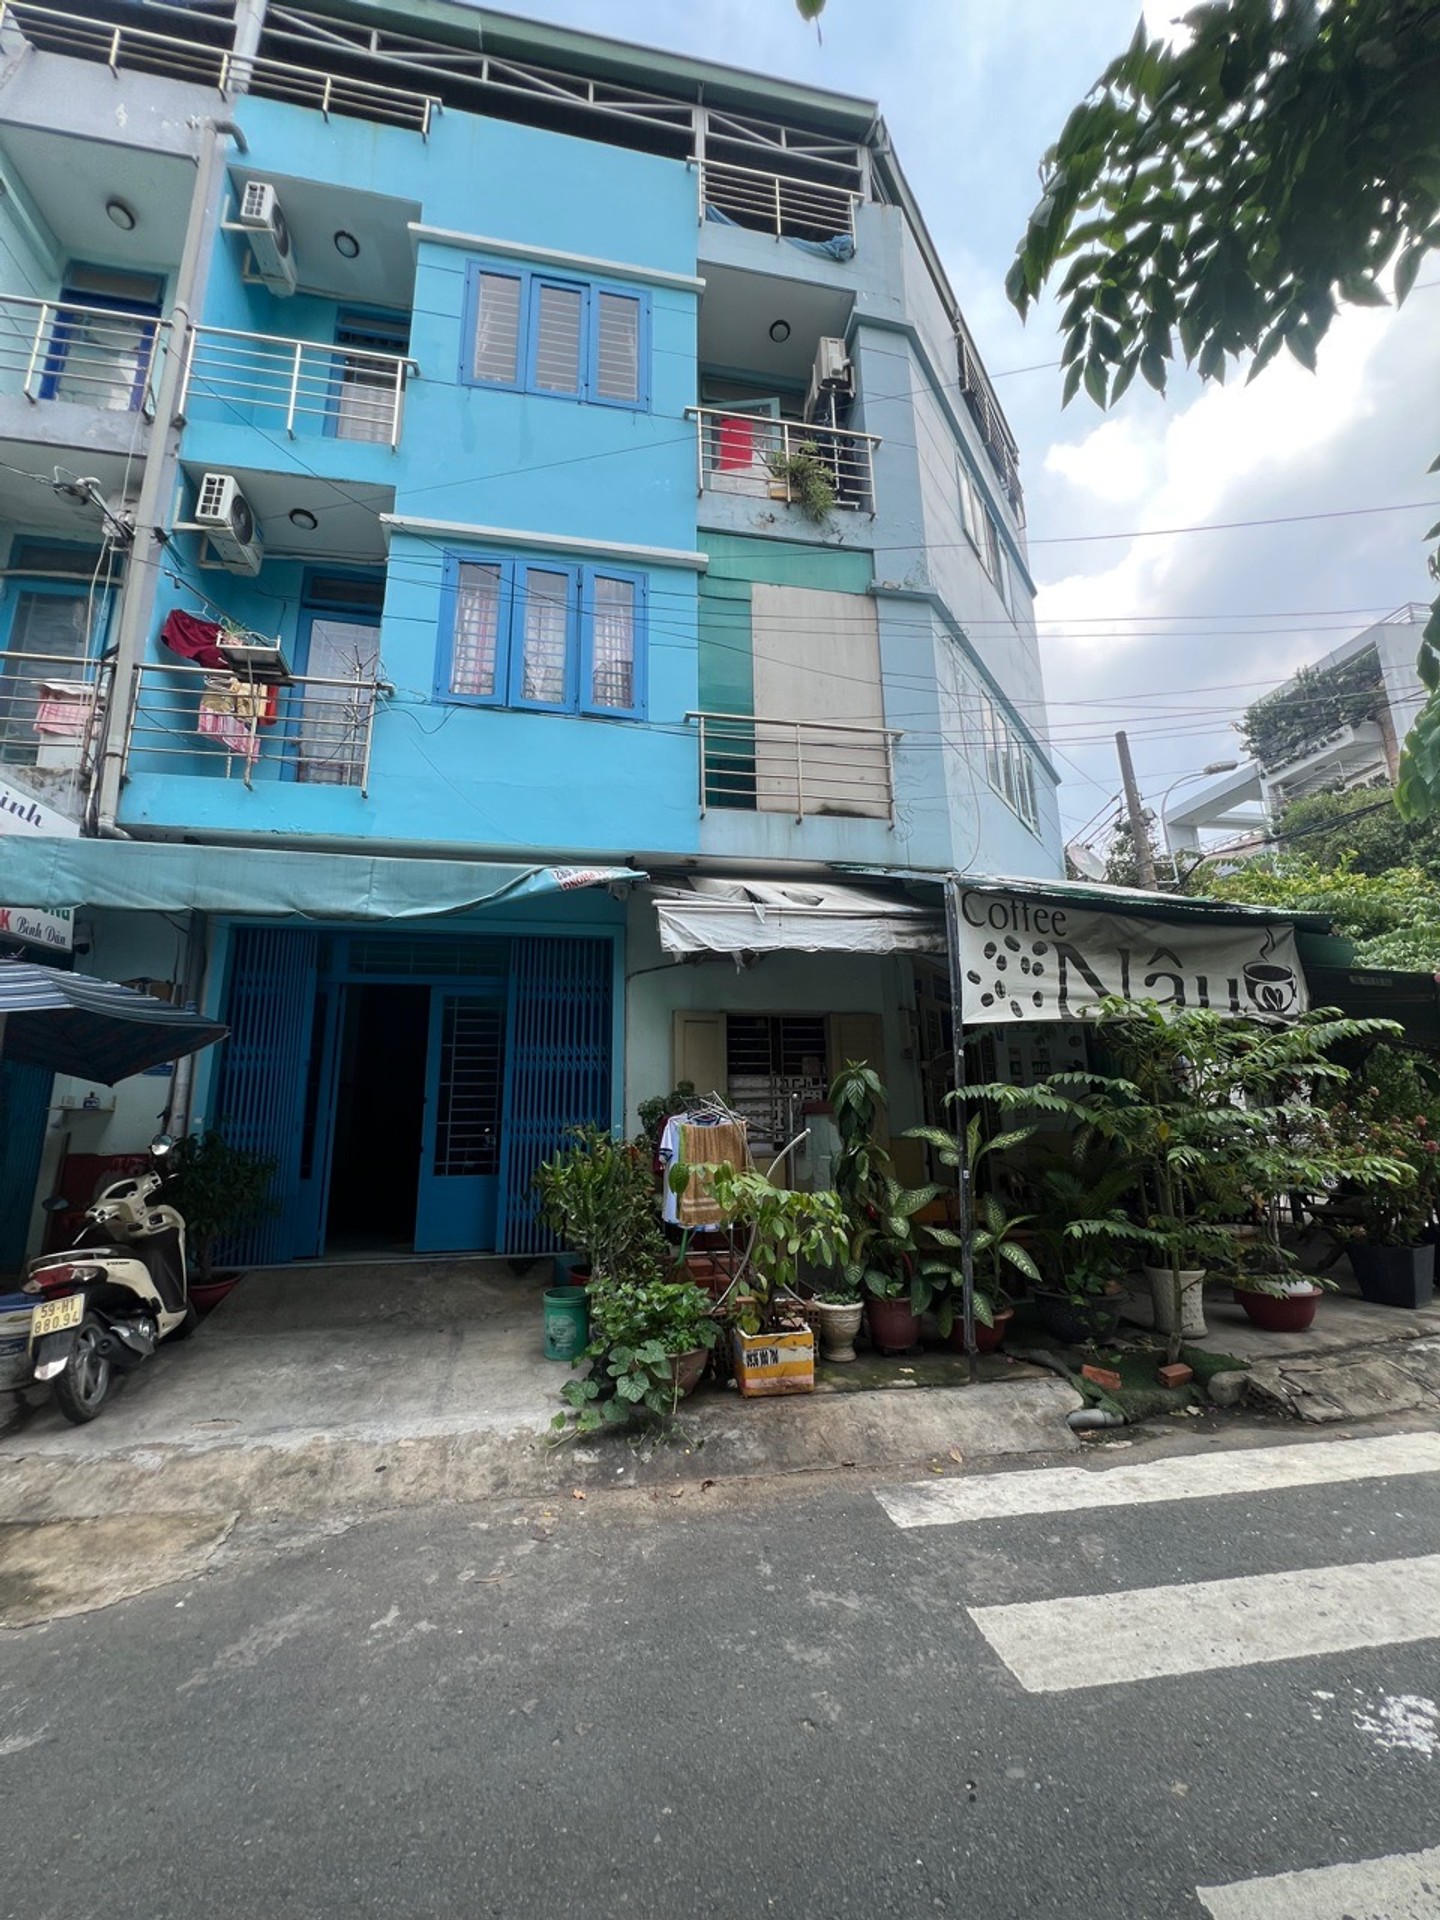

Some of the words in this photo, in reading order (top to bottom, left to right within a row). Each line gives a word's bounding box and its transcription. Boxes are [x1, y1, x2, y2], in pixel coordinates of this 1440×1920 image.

[0, 790, 43, 829] inh
[961, 889, 1067, 937] Coffee
[1052, 941, 1245, 1020] Nâu
